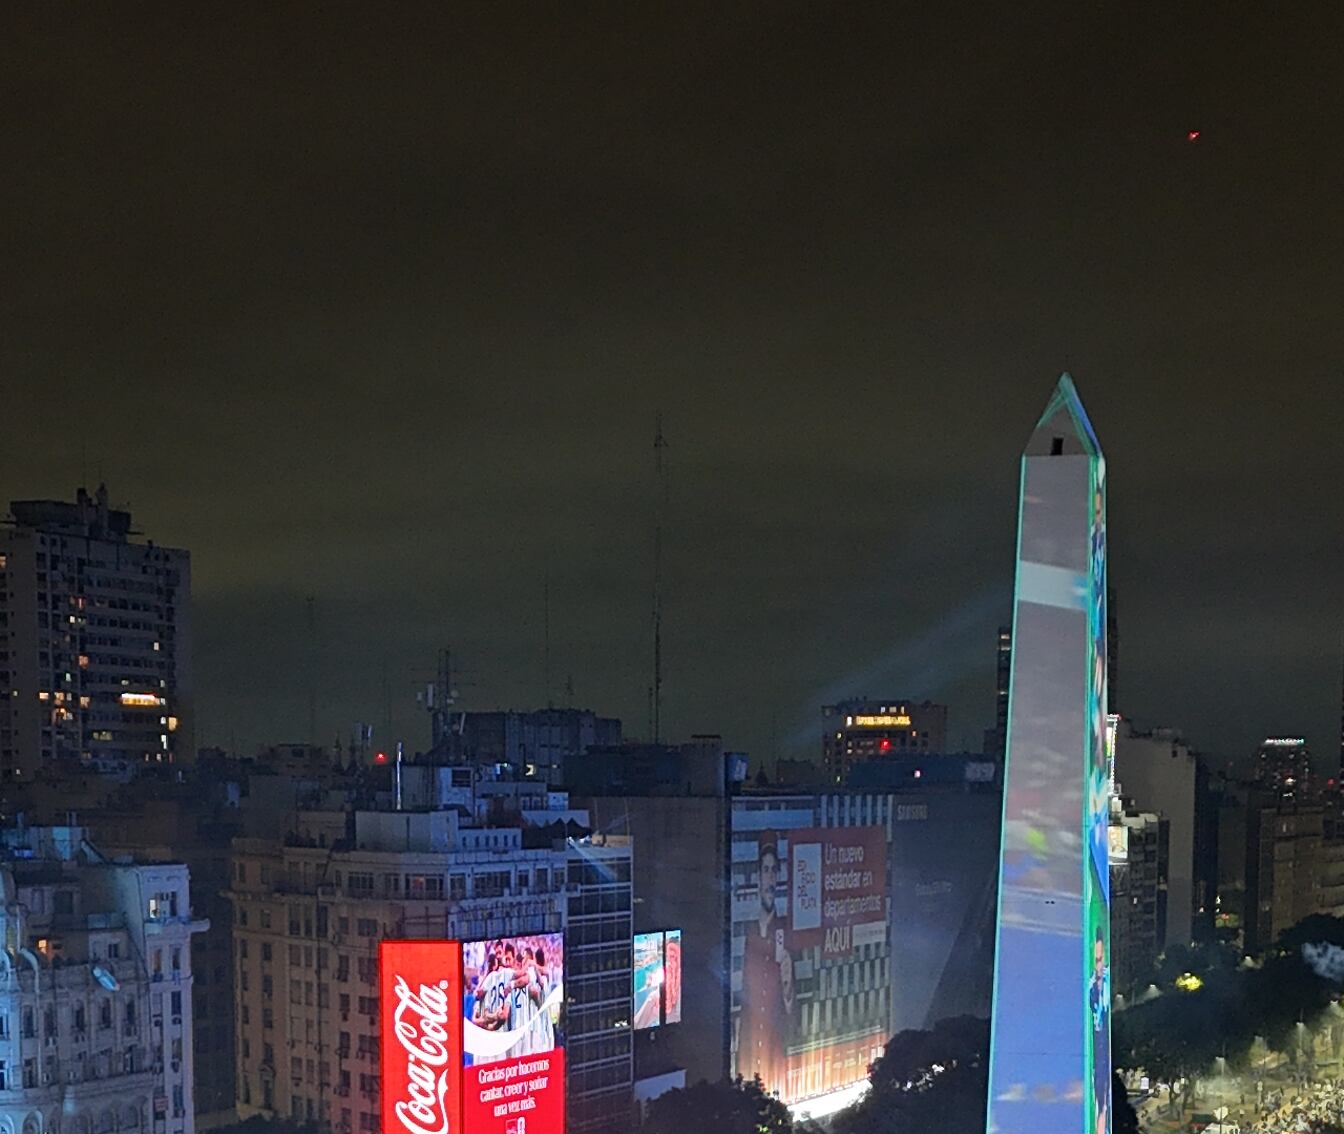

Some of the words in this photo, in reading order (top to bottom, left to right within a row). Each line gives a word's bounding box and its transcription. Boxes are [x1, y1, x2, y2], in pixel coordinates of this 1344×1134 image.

[825, 843, 836, 865] Un
[838, 845, 864, 864] nuevo
[824, 868, 861, 891] estándar
[862, 870, 873, 887] en
[824, 919, 851, 953] AQUÍ
[478, 1066, 505, 1084] Gracias
[505, 1064, 518, 1082] por
